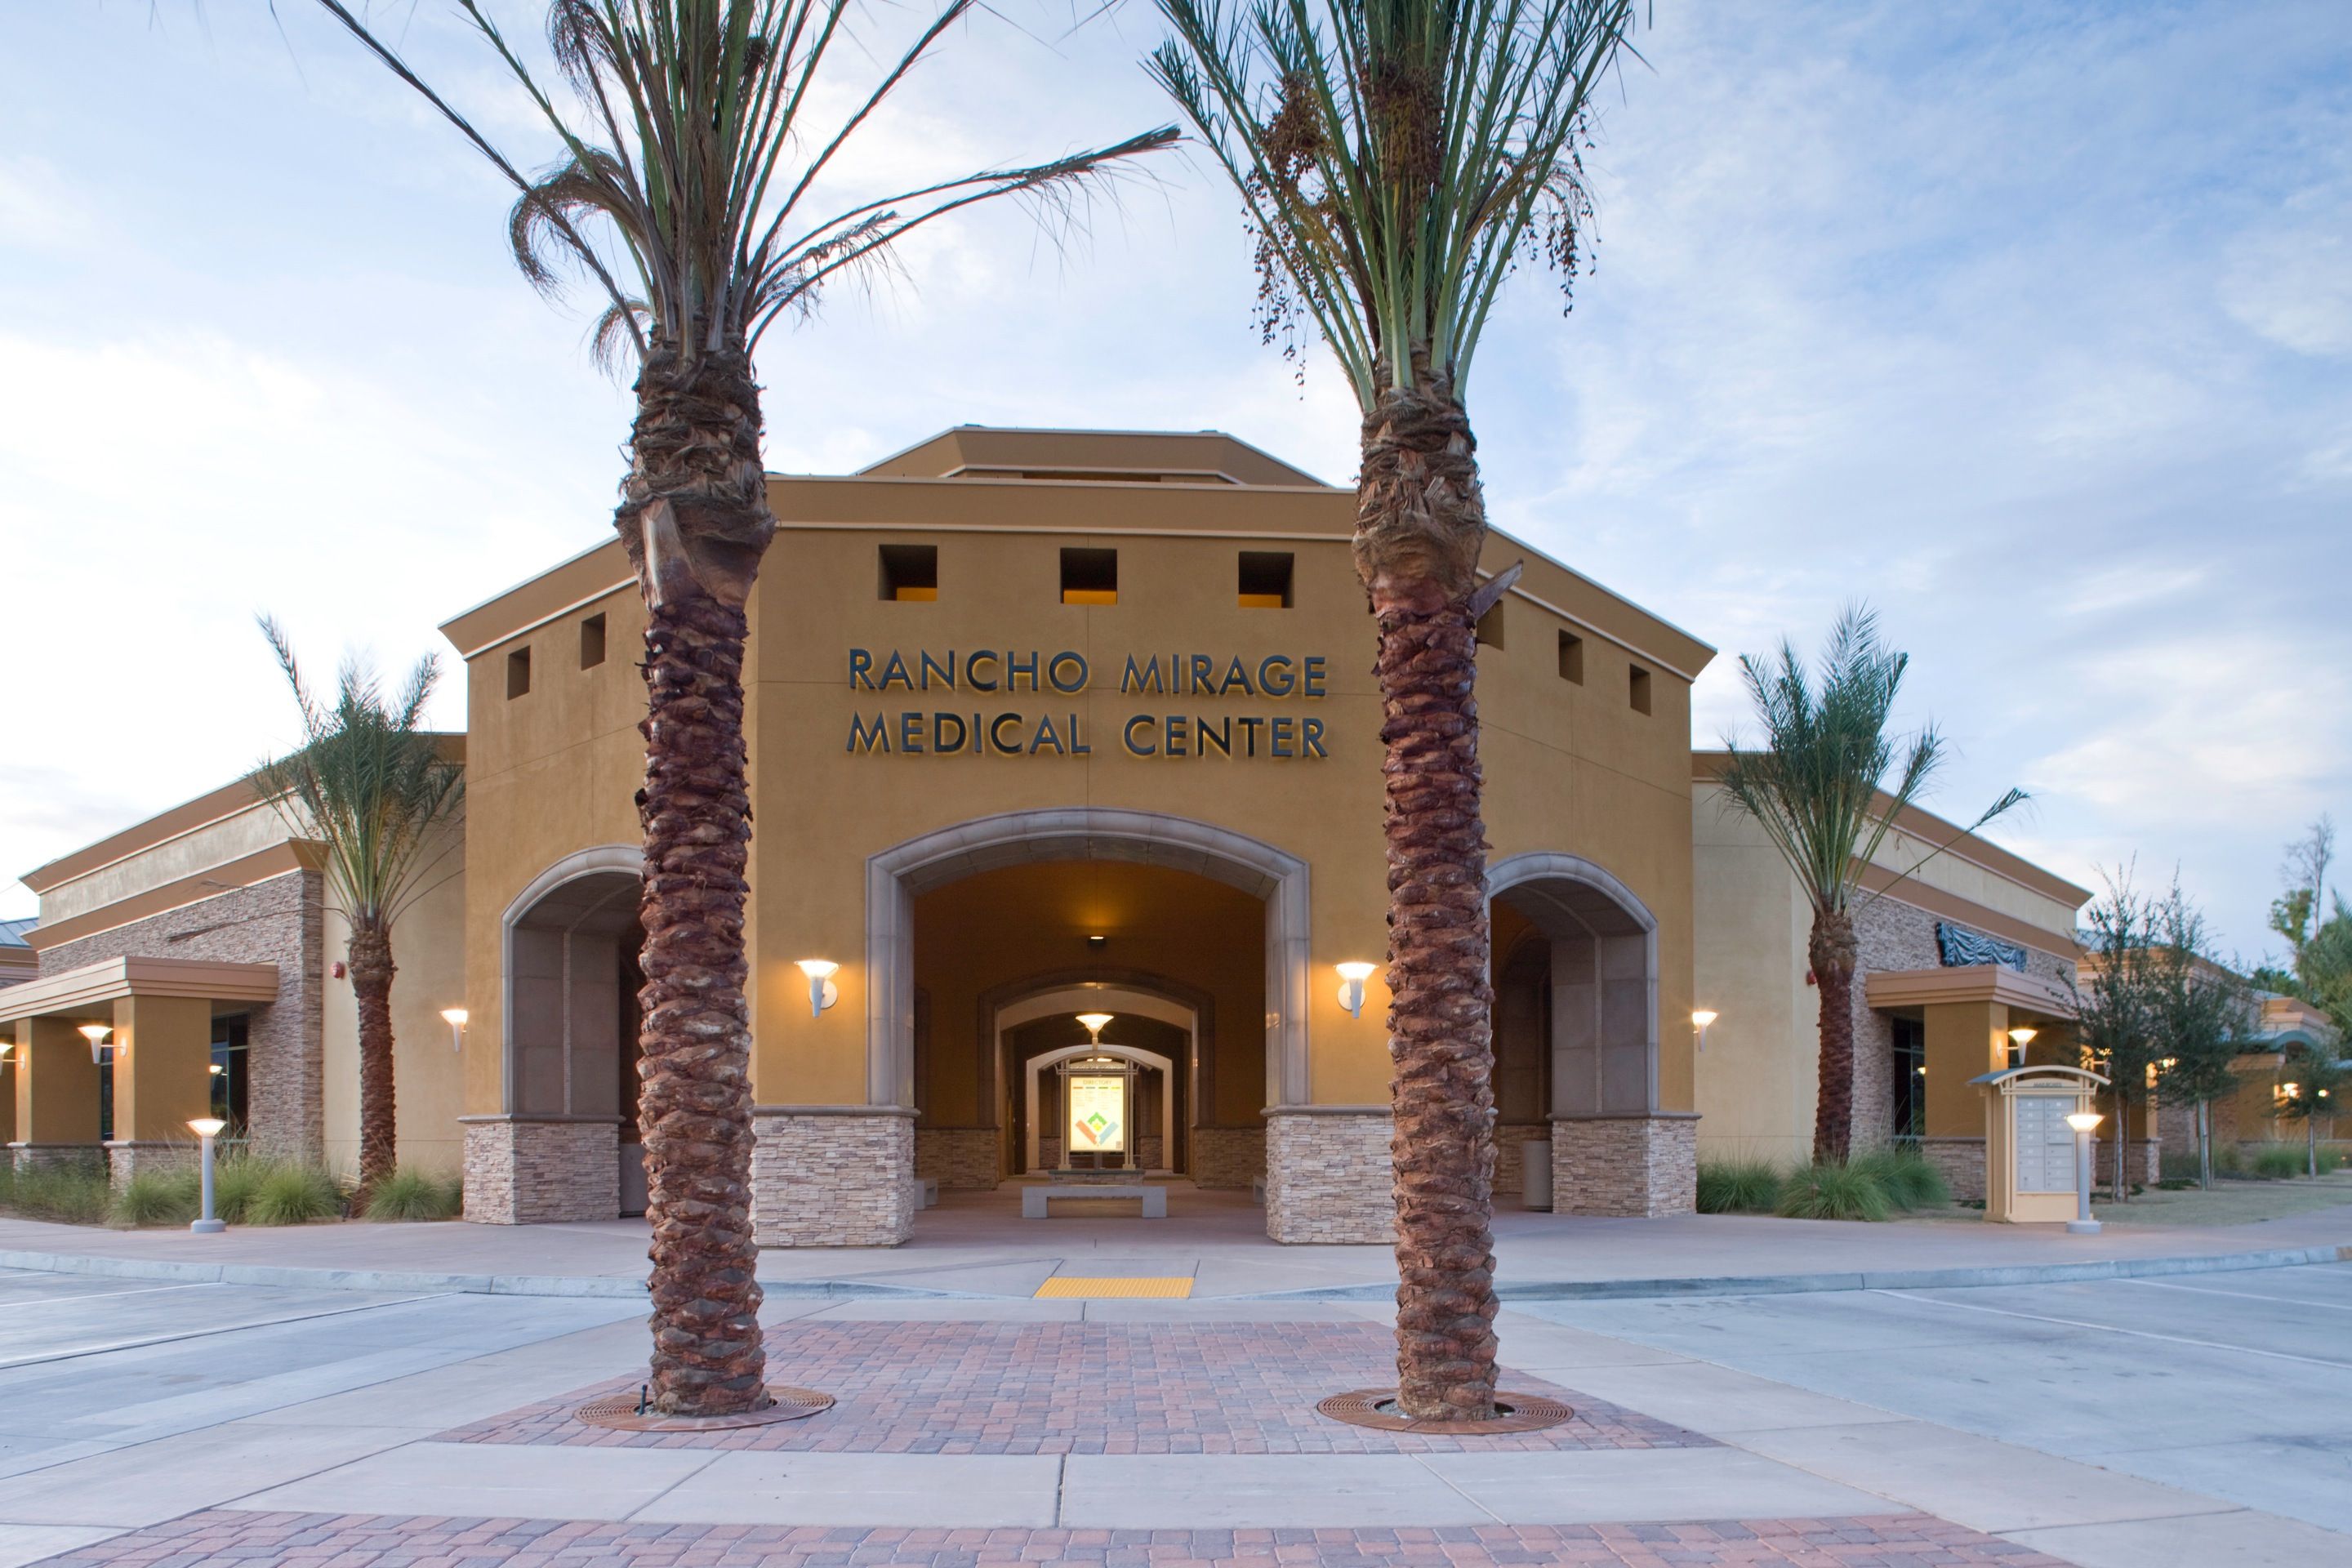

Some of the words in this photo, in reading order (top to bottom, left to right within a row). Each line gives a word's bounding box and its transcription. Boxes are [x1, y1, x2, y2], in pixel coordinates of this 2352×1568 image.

[849, 648, 1090, 693] RANCHO
[1120, 653, 1327, 697] MIRAGE
[846, 711, 1092, 754] MEDICAL
[1123, 714, 1329, 758] CENTER
